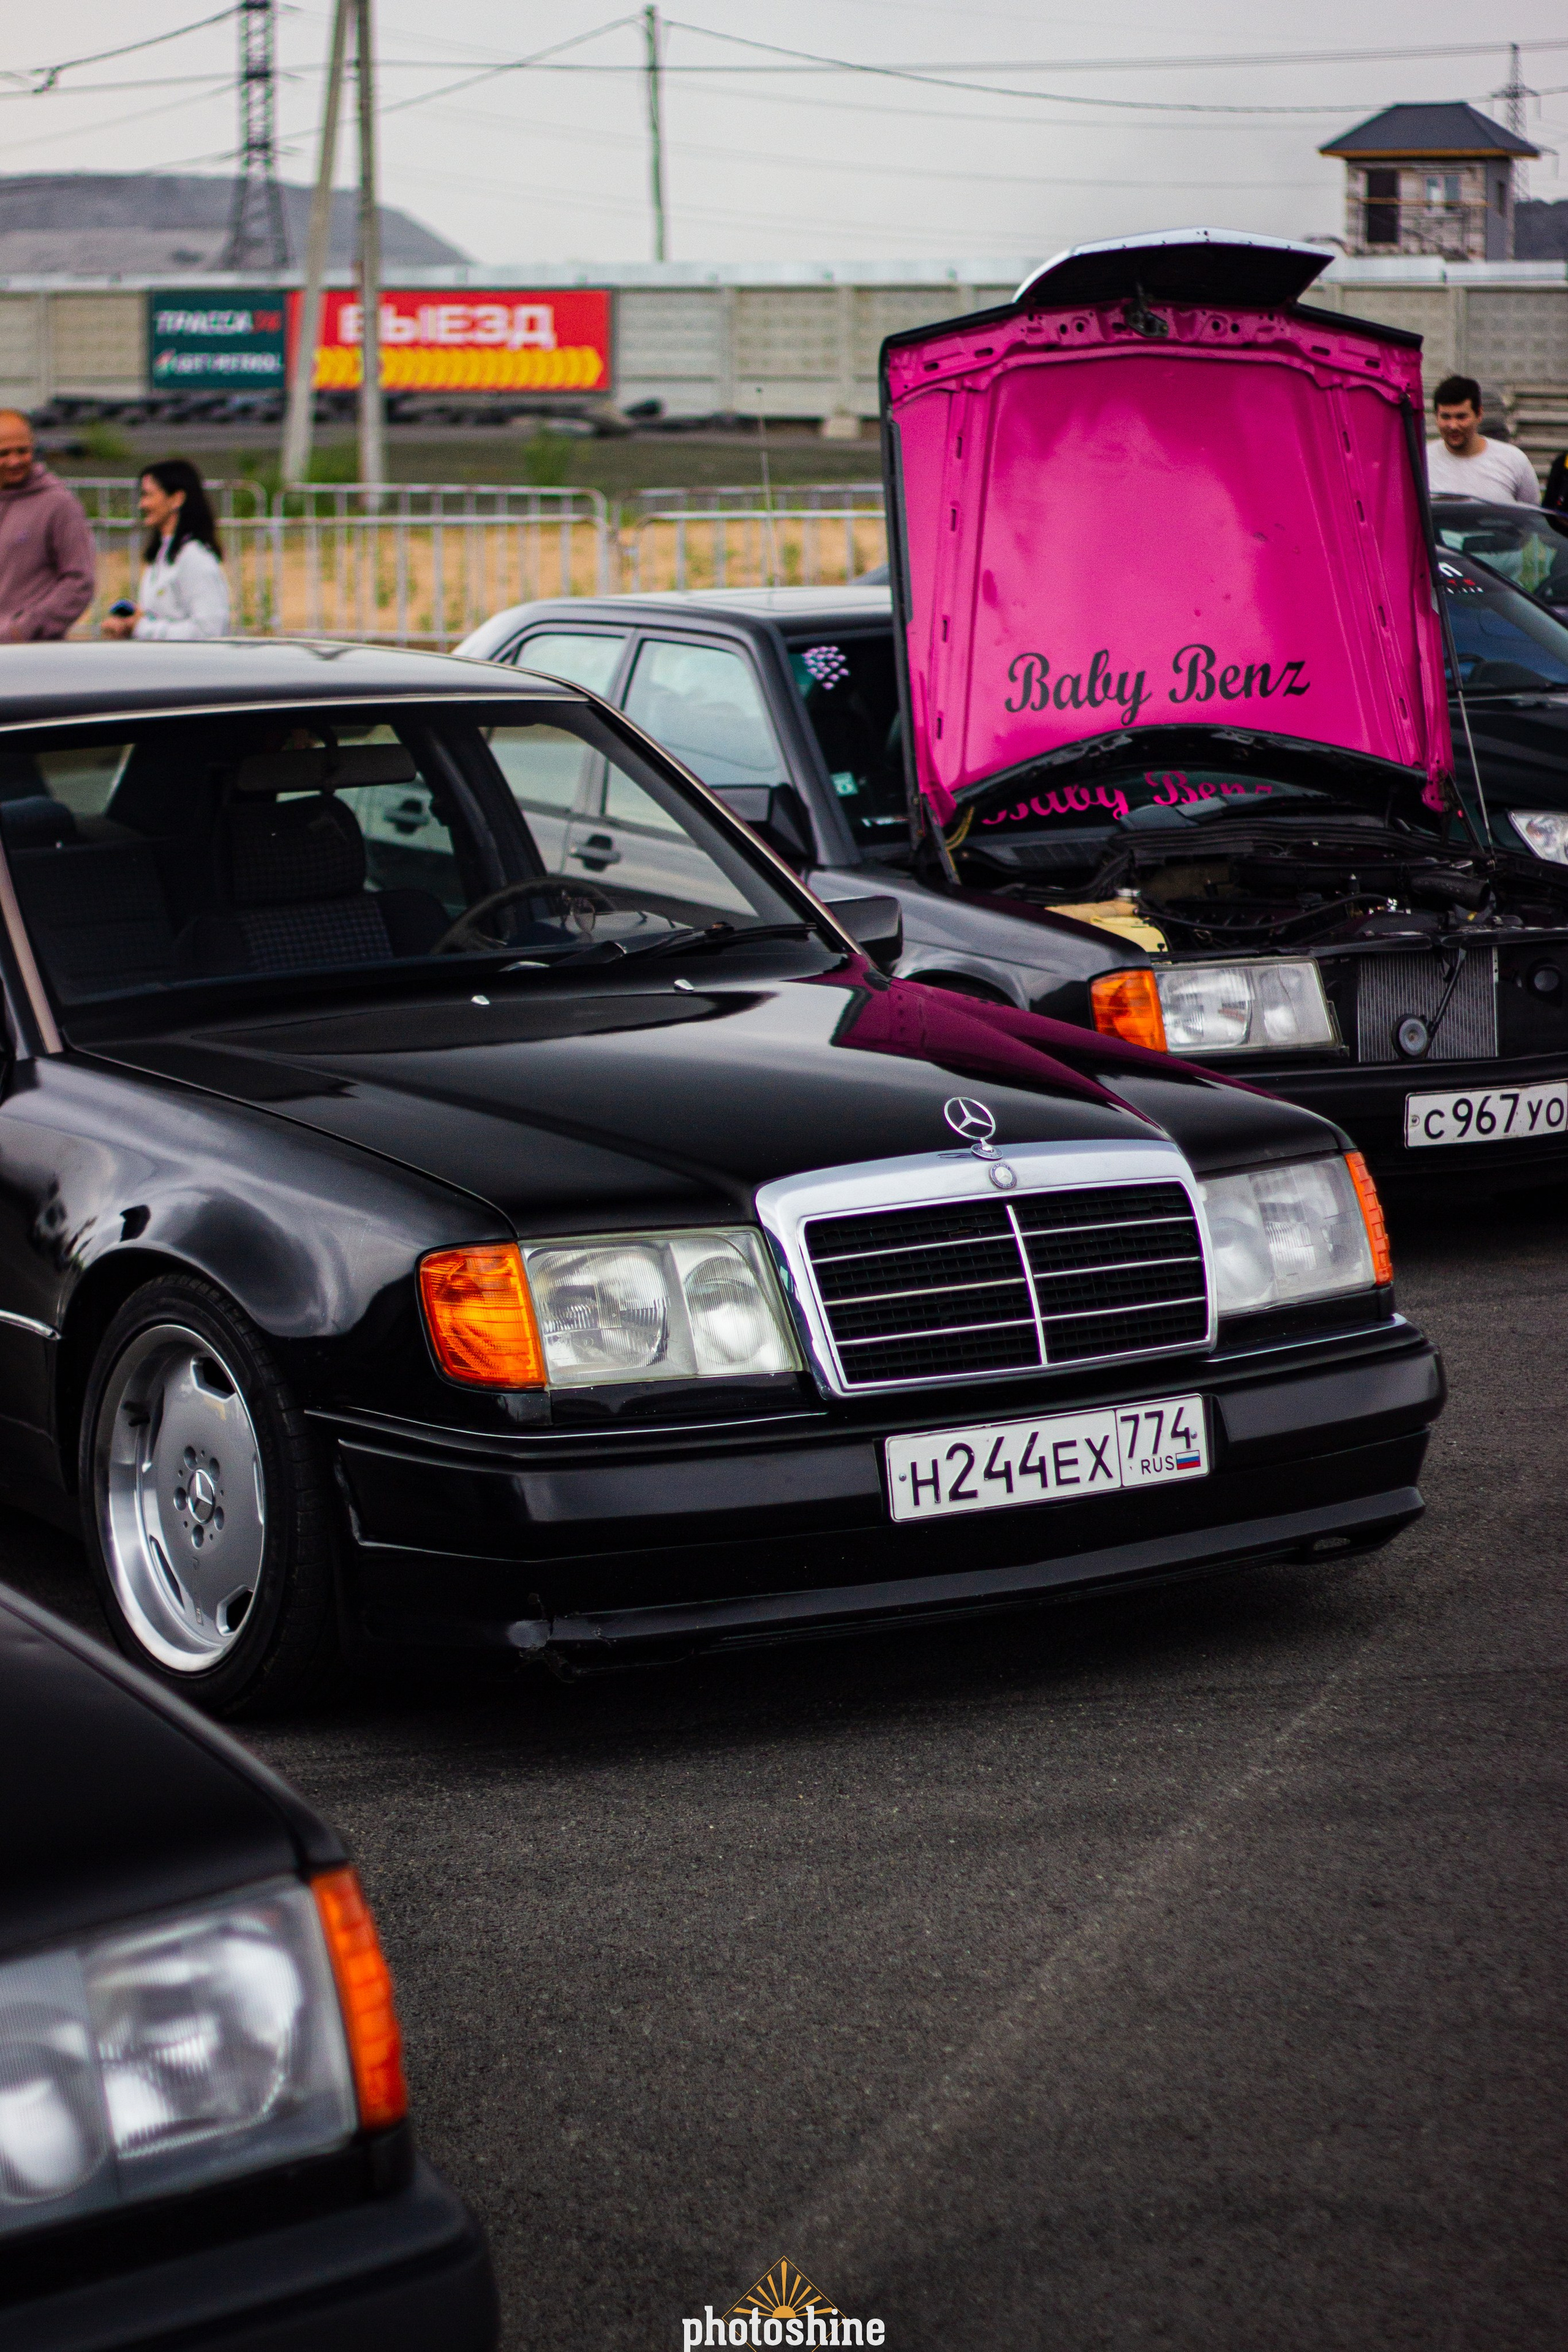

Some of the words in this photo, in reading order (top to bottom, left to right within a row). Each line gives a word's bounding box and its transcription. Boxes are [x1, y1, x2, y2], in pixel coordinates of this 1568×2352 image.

[339, 304, 557, 350] ВЫЕЗД
[1005, 649, 1152, 726] Baby
[1169, 644, 1310, 704] Benz
[1120, 1406, 1191, 1458] 774
[1141, 1455, 1175, 1475] RUS
